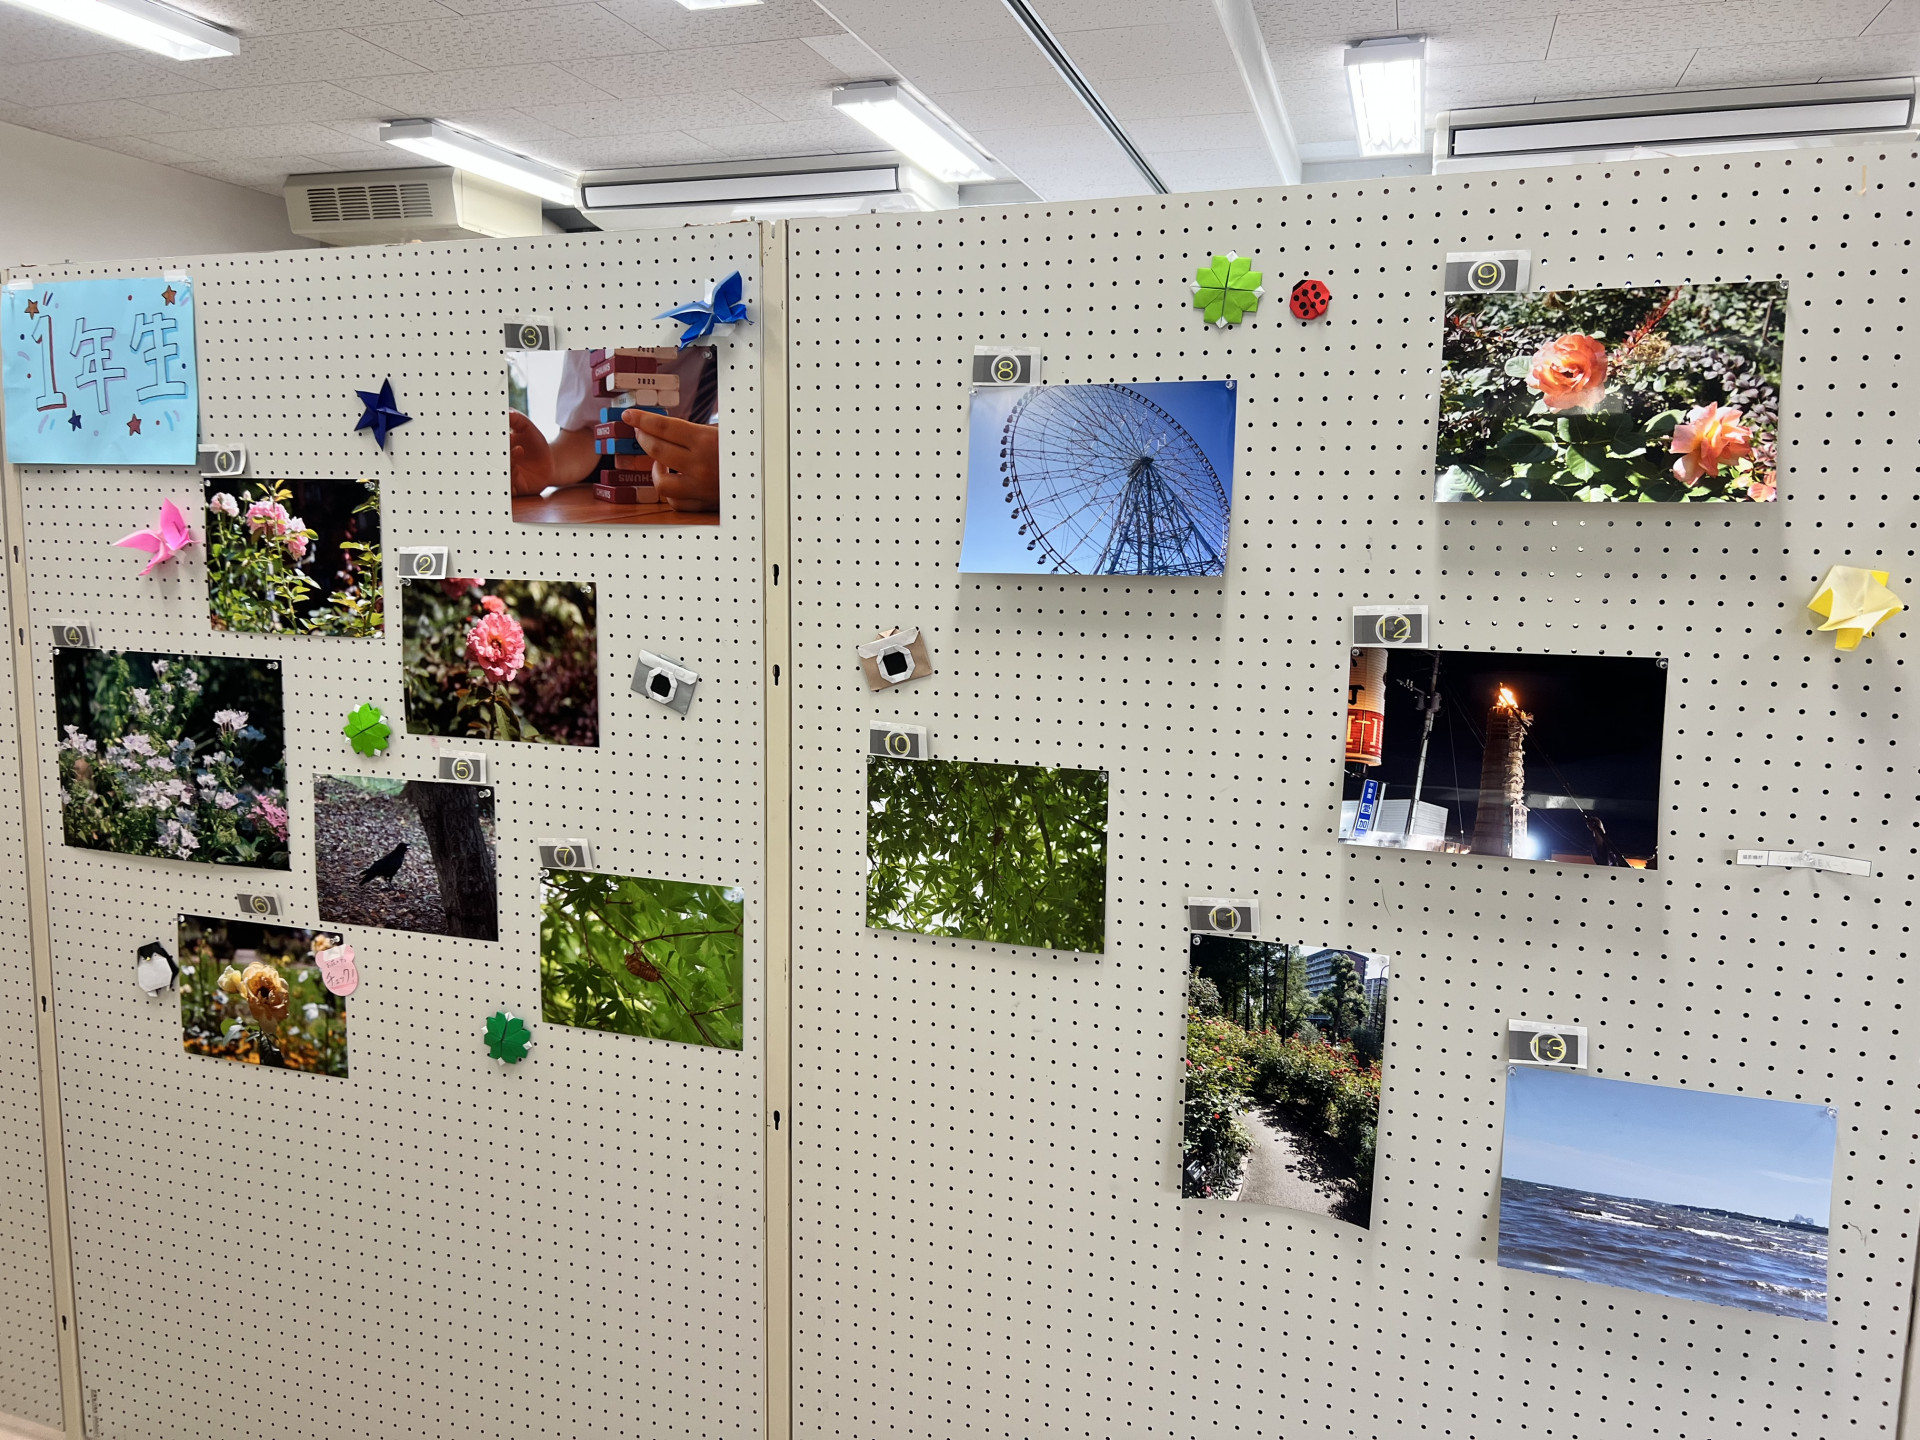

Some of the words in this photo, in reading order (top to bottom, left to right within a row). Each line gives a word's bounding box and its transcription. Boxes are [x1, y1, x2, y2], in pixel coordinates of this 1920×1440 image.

[1477, 263, 1498, 286] 9
[524, 328, 536, 346] 3
[31, 312, 188, 415] 1年生
[997, 360, 1014, 381] 8
[220, 454, 227, 469] 1
[418, 556, 431, 574] 2
[69, 628, 79, 643] 4
[1376, 617, 1411, 639] 12
[883, 735, 910, 754] 10
[456, 761, 469, 779] 5
[557, 848, 570, 865] 7
[254, 898, 267, 913] 6
[1208, 909, 1236, 929] 11
[1529, 1037, 1566, 1060] 13
